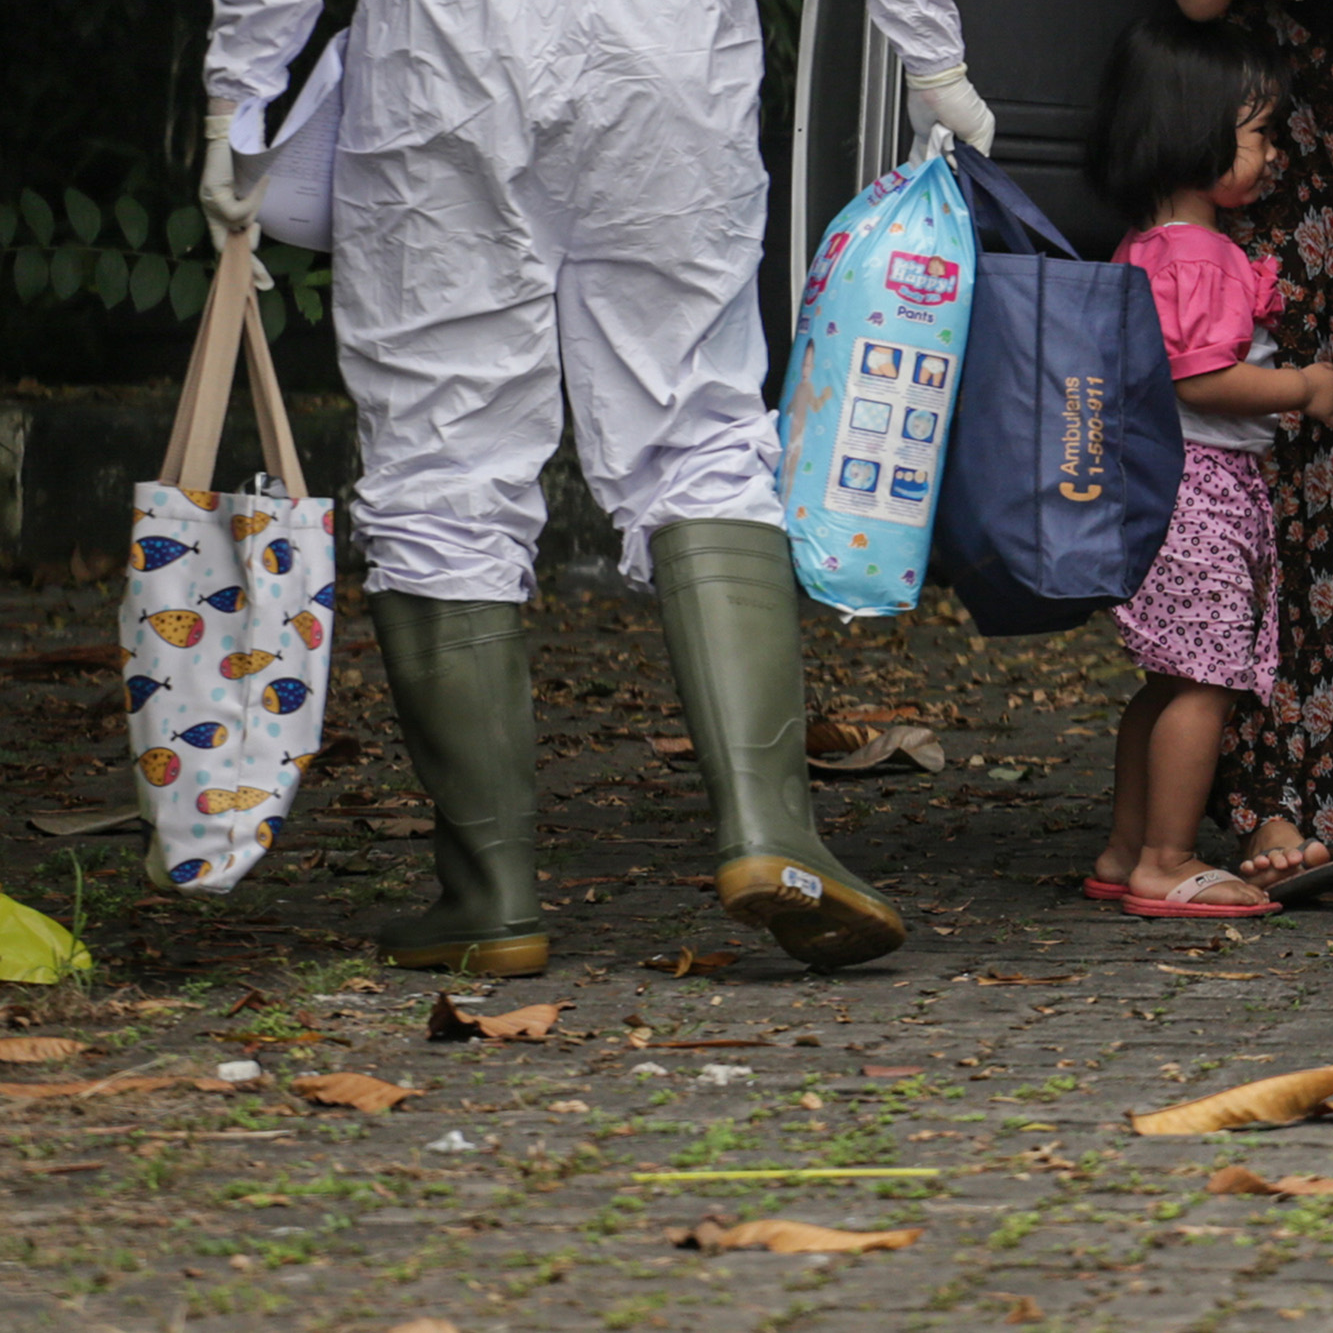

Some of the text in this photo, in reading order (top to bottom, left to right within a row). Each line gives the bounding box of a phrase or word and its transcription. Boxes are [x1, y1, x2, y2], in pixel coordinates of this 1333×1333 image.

[890, 268, 957, 294] Happy!
[897, 306, 934, 323] Pants
[1060, 377, 1081, 476] Ambulens
[1086, 376, 1104, 476] 1-500-911
